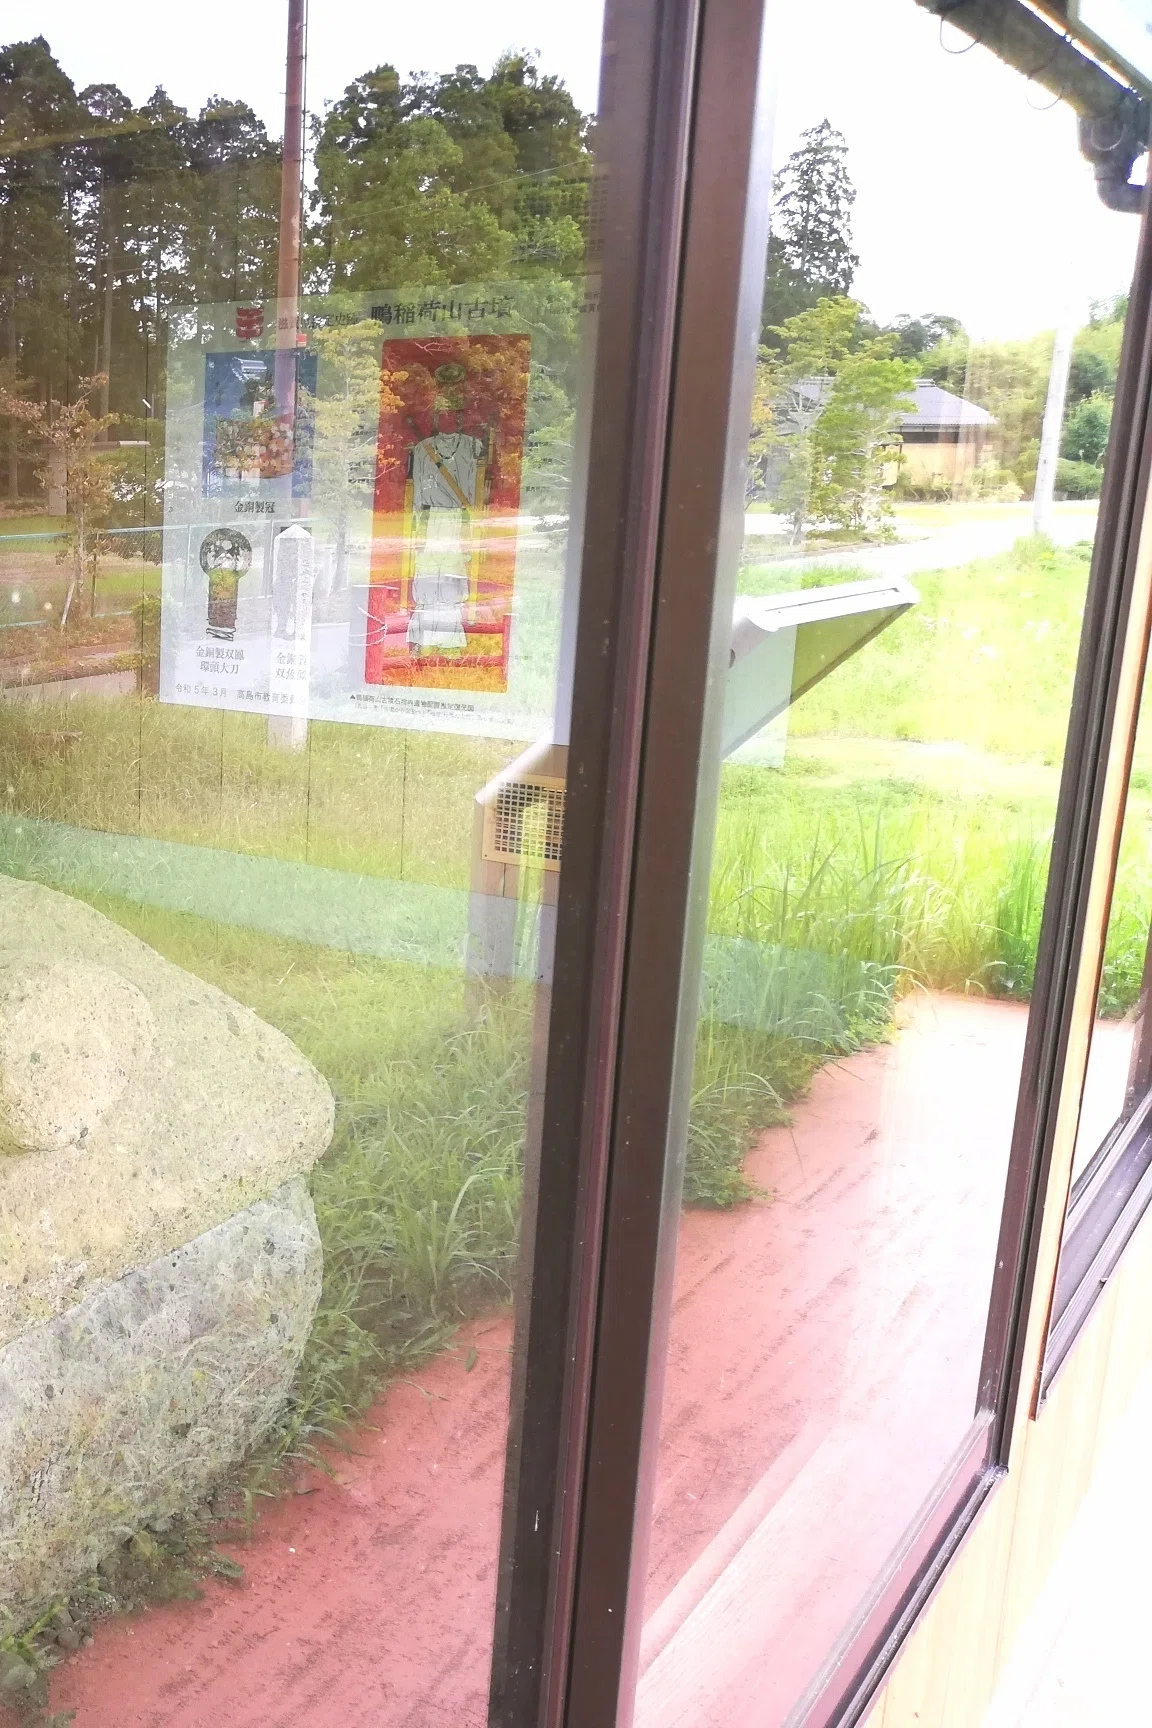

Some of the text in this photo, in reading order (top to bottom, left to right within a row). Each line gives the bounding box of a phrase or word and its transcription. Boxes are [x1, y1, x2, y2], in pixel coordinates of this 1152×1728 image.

[234, 500, 276, 514] 金銅製冠
[200, 660, 239, 675] 環頭大刀
[236, 689, 307, 705] 高島市教育委員
